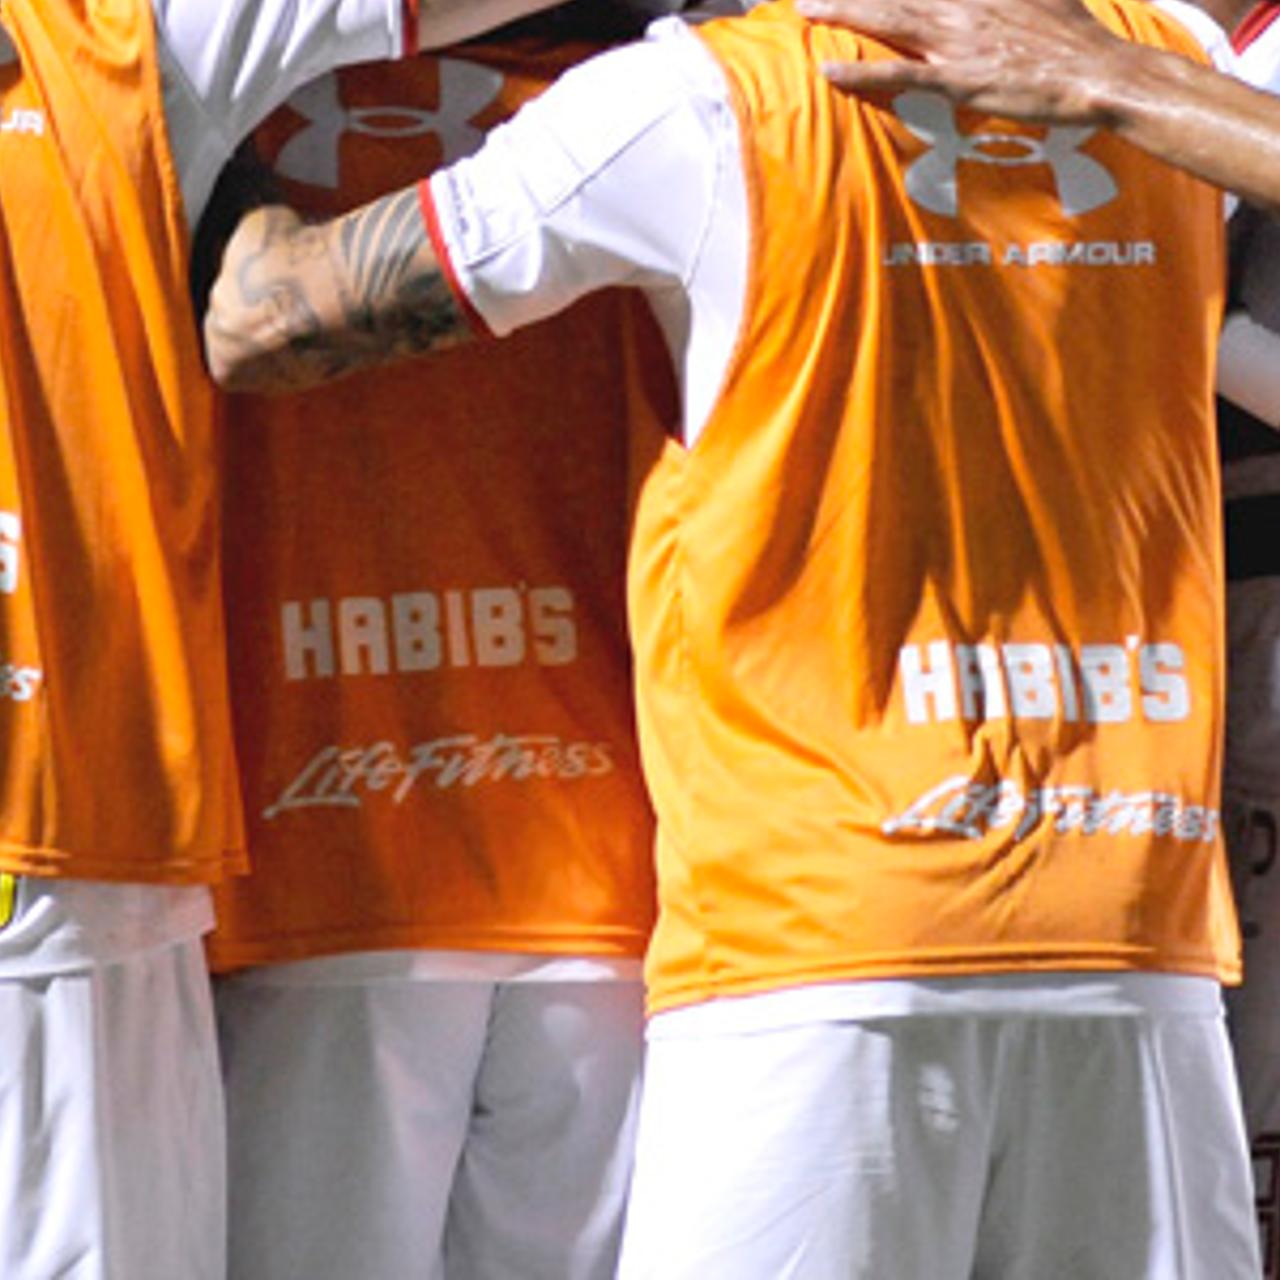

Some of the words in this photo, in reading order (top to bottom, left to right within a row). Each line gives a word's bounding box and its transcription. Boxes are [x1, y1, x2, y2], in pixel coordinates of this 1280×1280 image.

[1001, 239, 1157, 267] ARMOUR
[279, 580, 579, 681] HABIB'S
[898, 633, 1191, 725] HABIB'S
